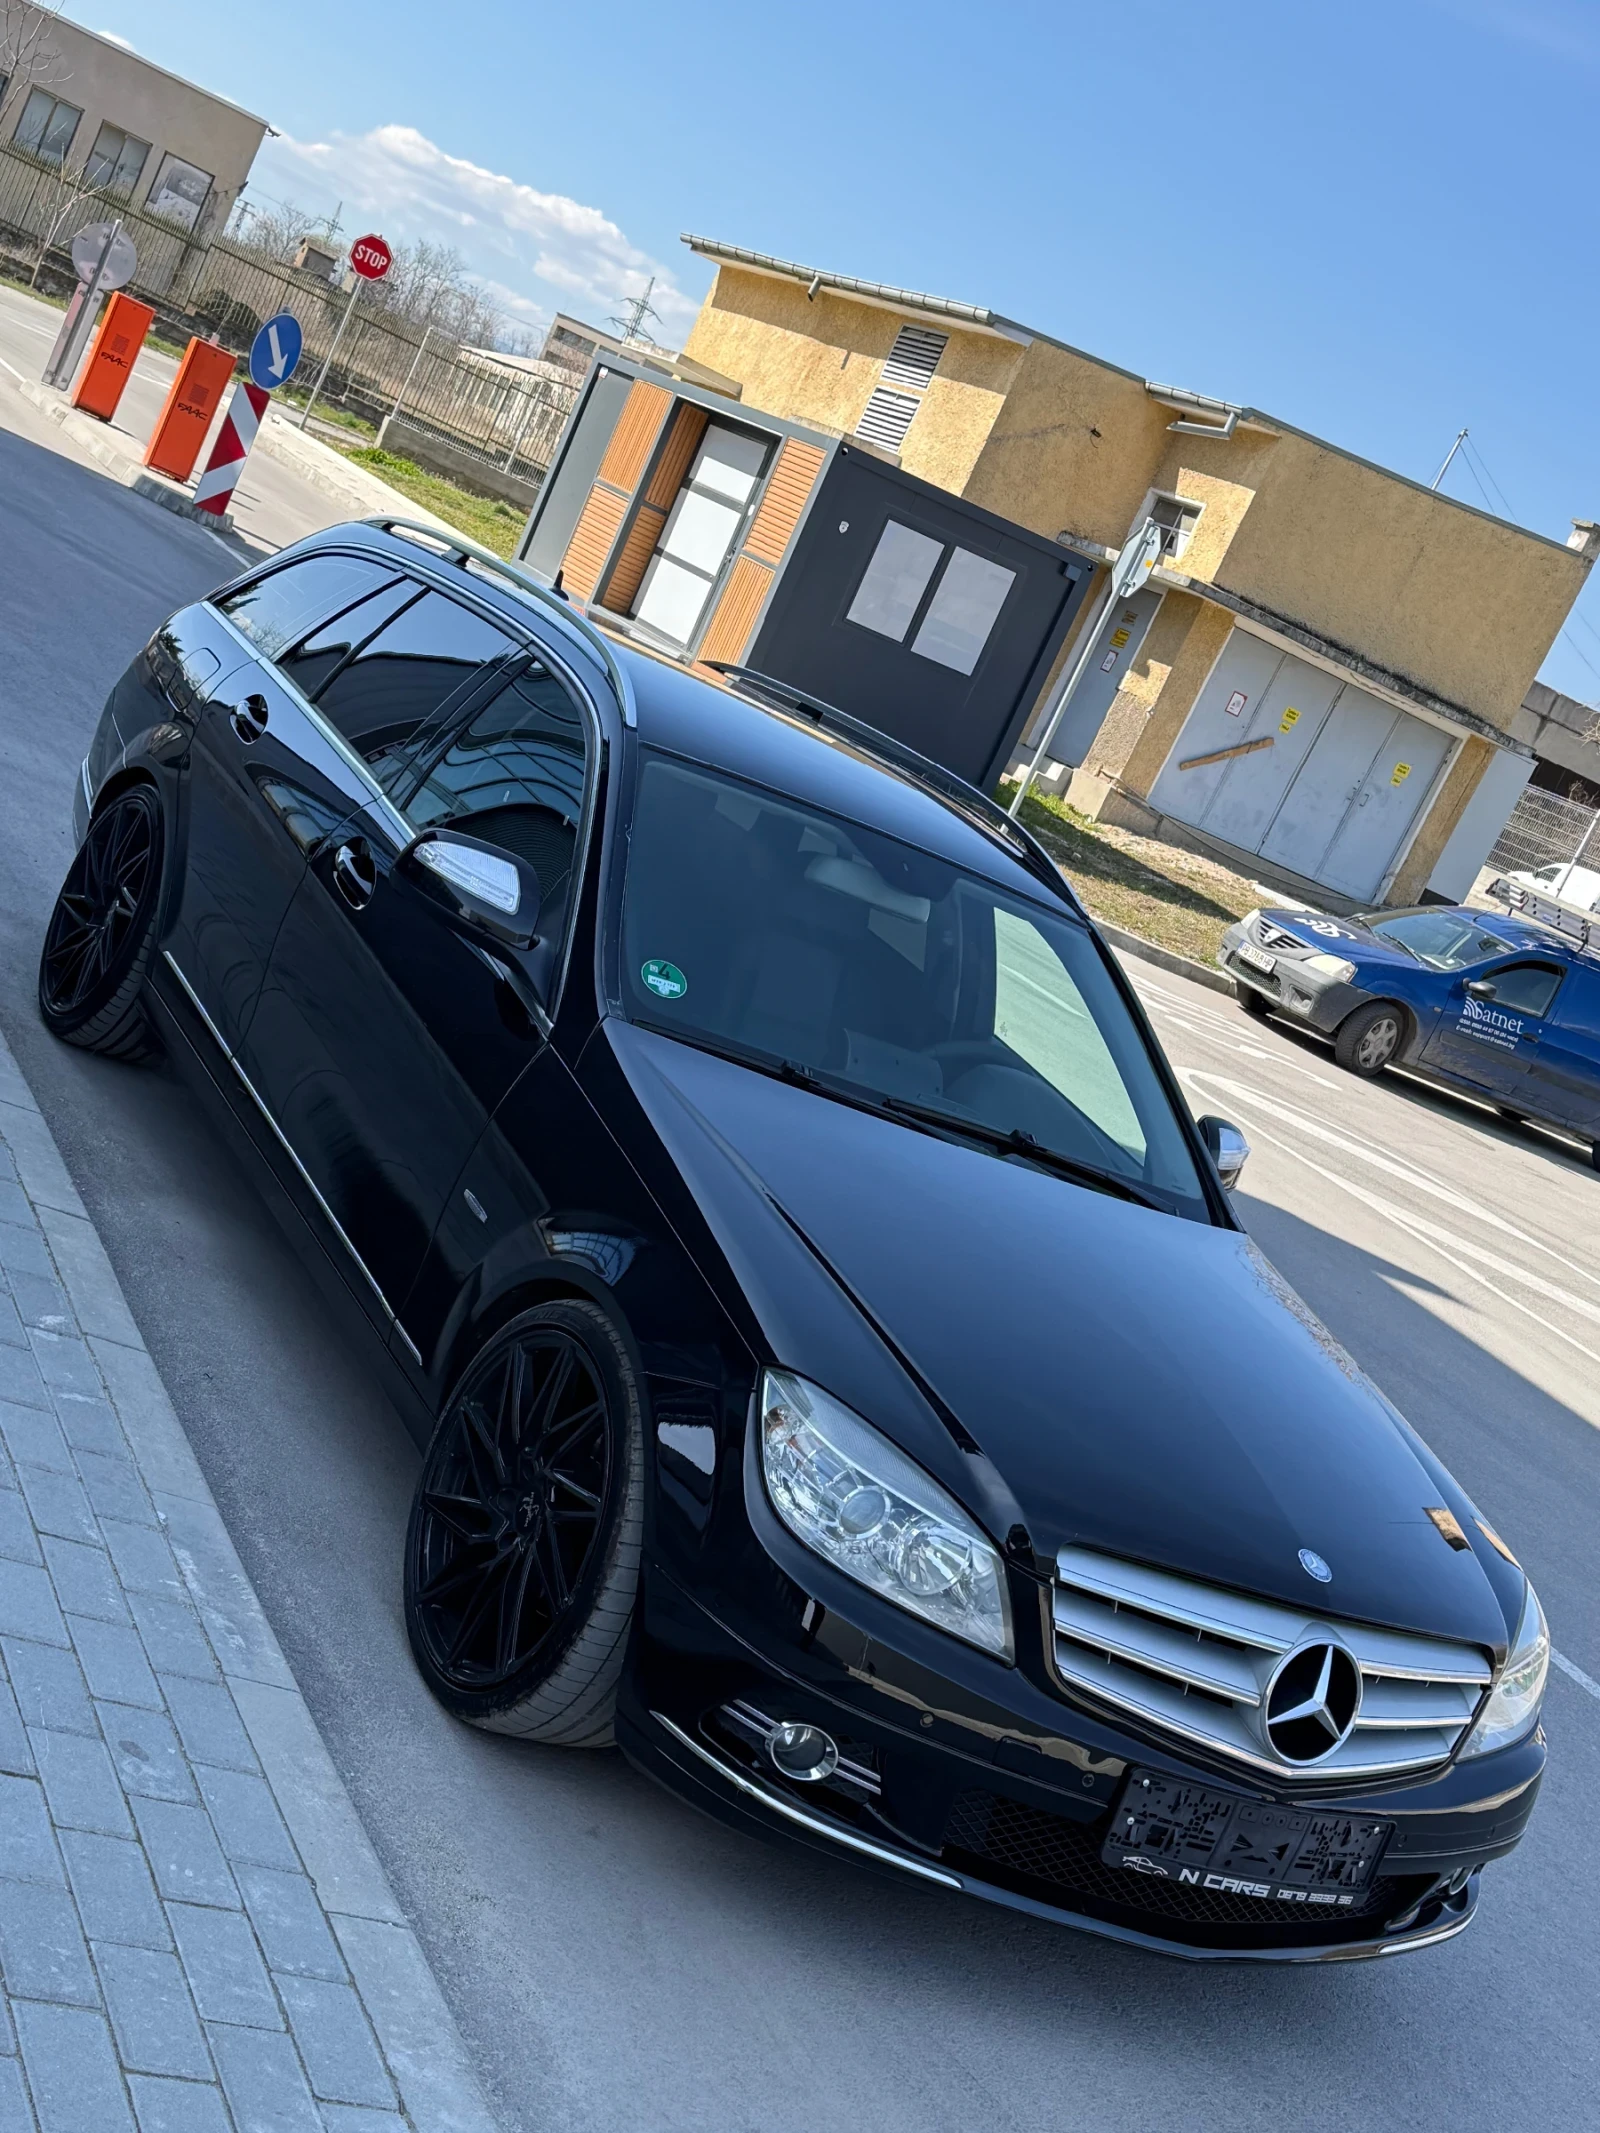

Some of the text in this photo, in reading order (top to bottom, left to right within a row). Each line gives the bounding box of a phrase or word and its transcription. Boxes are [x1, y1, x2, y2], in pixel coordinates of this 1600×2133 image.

[355, 244, 388, 270] STOP
[101, 351, 129, 369] FAAC
[178, 402, 208, 421] FAAC
[658, 963, 671, 980] 4
[1470, 1000, 1524, 1035] Satnet
[1178, 1868, 1200, 1884] N
[1203, 1873, 1271, 1898] CARS
